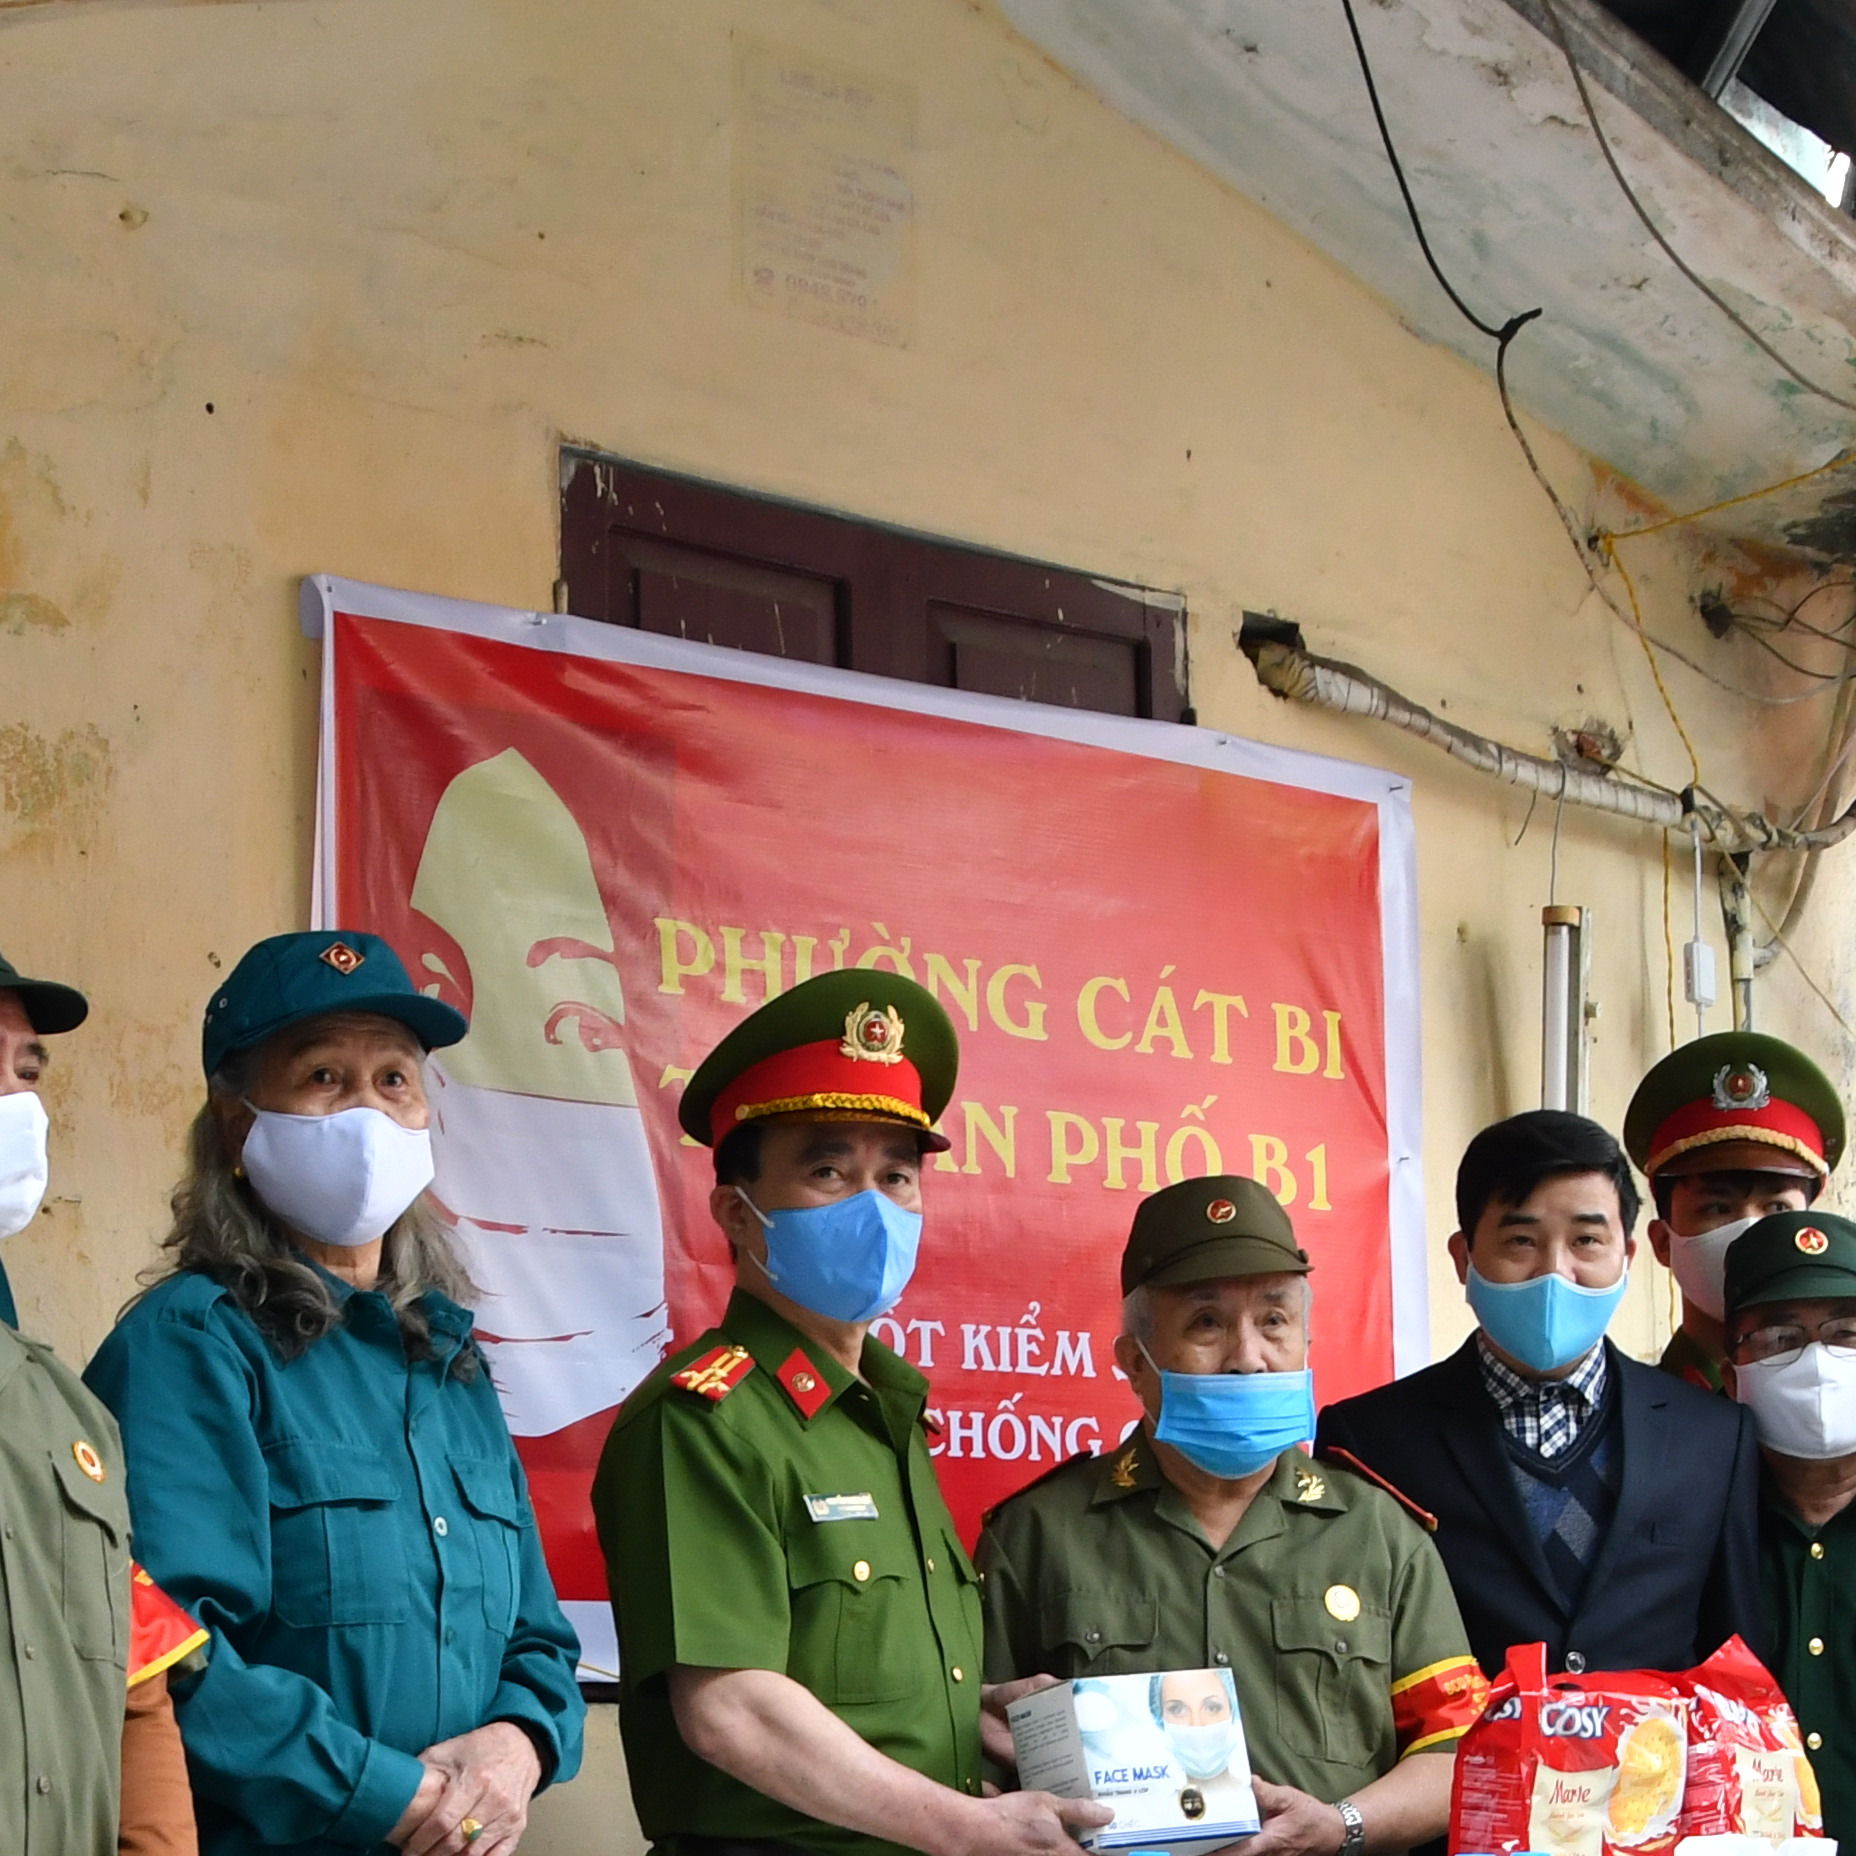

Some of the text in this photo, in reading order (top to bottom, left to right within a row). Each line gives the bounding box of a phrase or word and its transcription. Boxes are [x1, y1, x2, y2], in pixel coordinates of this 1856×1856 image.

[1076, 964, 1249, 1065] CÁT
[1270, 1001, 1345, 1080] BI
[1045, 1094, 1223, 1194] PHỐ
[1248, 1133, 1333, 1211] B1
[960, 1300, 1097, 1378] KIỂM
[1540, 1702, 1610, 1738] COSY
[1094, 1764, 1170, 1785] FACE MASK
[1548, 1778, 1591, 1805] Marie
